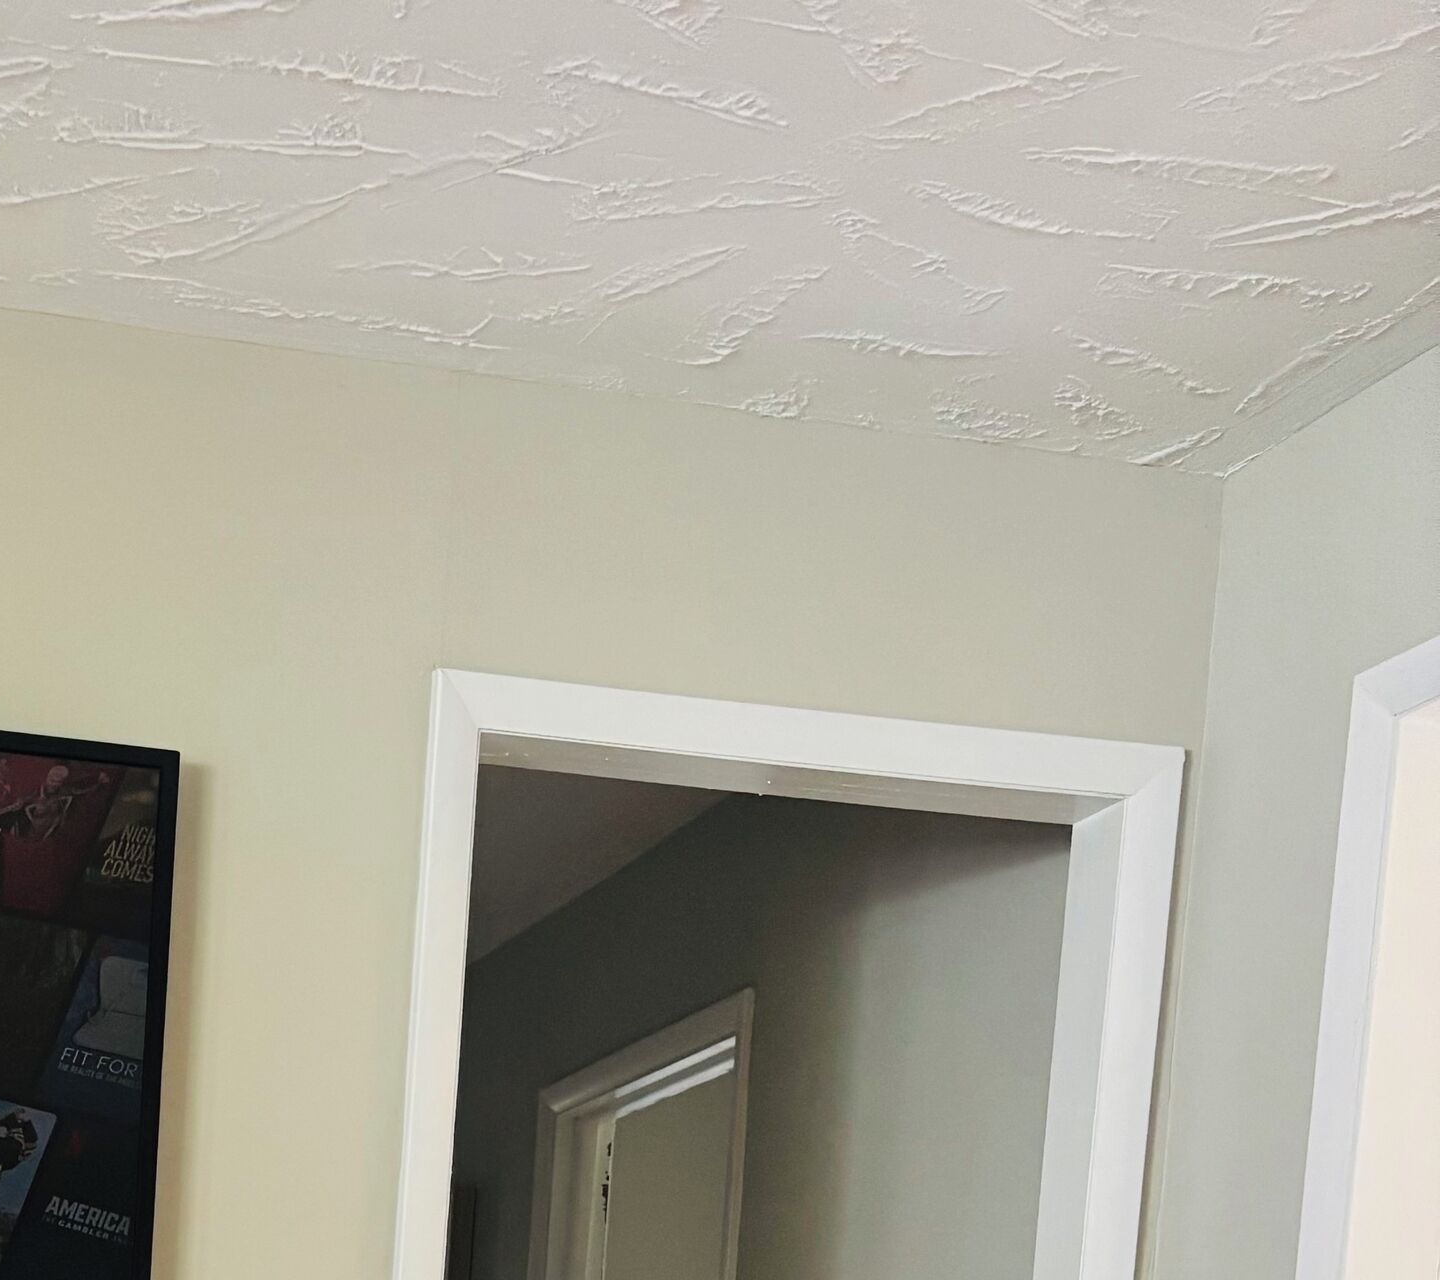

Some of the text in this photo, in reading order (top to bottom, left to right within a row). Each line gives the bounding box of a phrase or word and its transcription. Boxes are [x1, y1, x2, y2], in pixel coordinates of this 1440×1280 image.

[60, 1047, 138, 1077] FIT FOR
[45, 1195, 131, 1236] AMERICA
